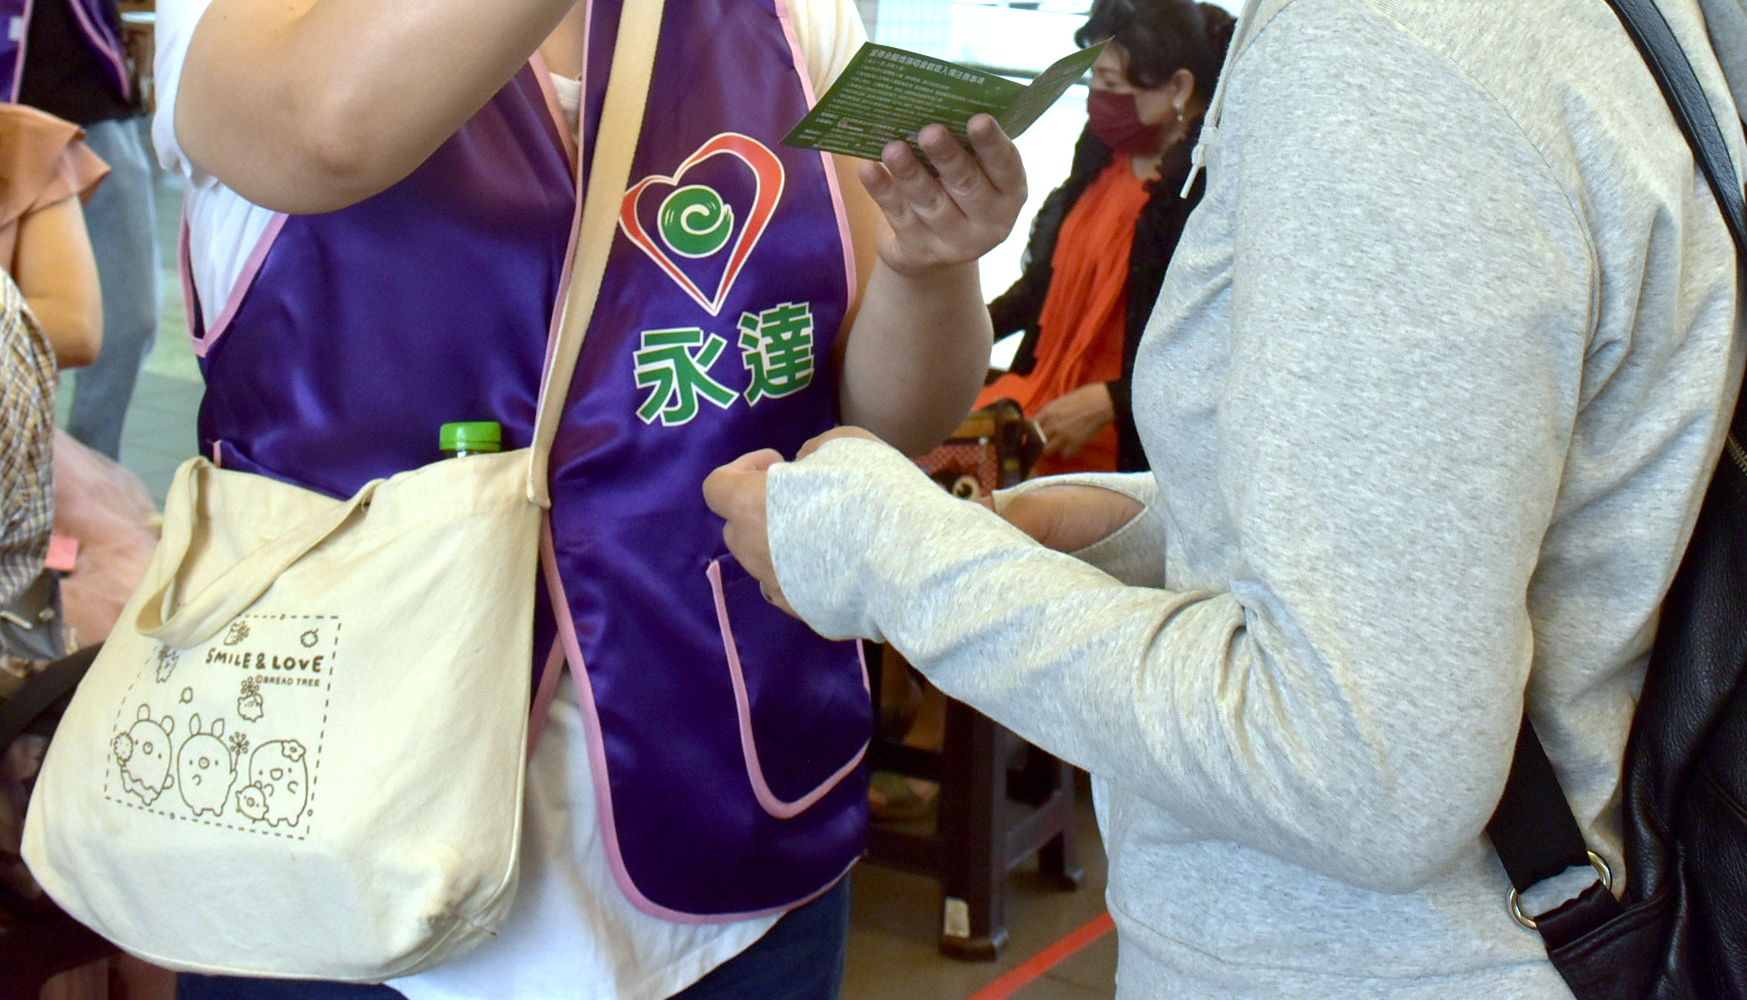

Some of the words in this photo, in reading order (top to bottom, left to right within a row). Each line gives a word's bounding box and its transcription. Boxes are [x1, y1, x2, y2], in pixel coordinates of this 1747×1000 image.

[633, 301, 815, 428] 永達
[205, 647, 252, 669] SMILE
[255, 652, 266, 670] &
[272, 655, 325, 673] LOVE
[296, 677, 321, 688] TREE
